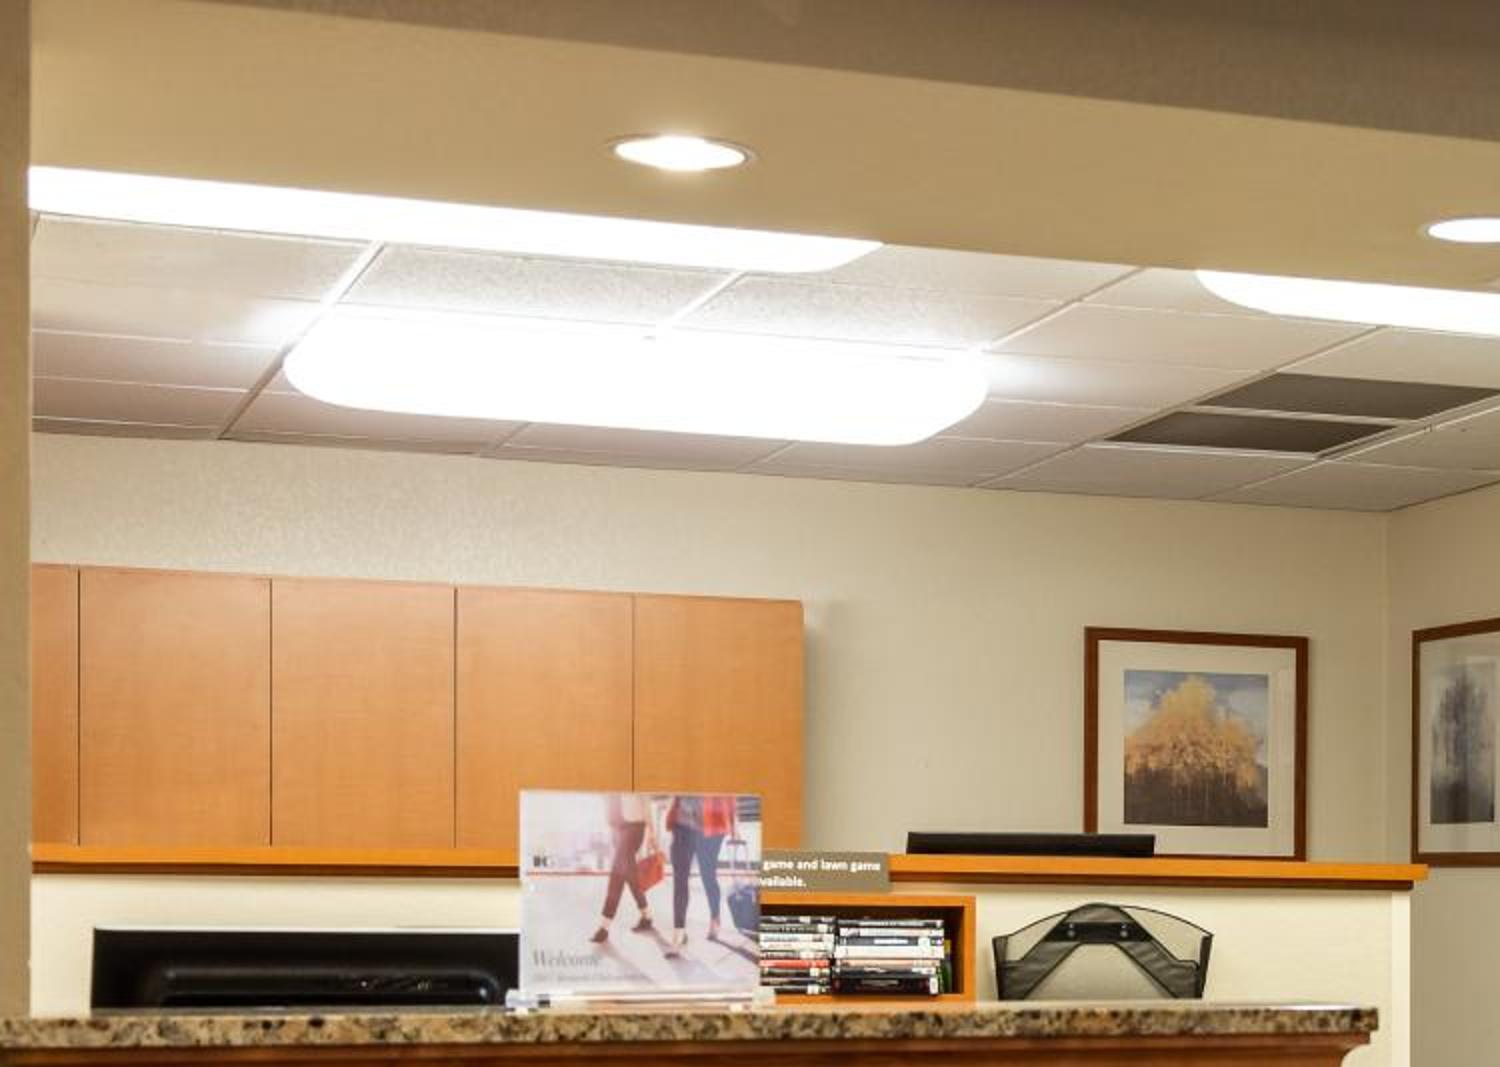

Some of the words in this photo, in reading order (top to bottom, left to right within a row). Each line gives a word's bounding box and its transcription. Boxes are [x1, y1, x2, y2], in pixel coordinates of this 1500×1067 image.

[763, 861, 794, 871] game
[797, 859, 818, 871] and
[821, 859, 848, 870] lawn
[760, 876, 807, 887] vailable.
